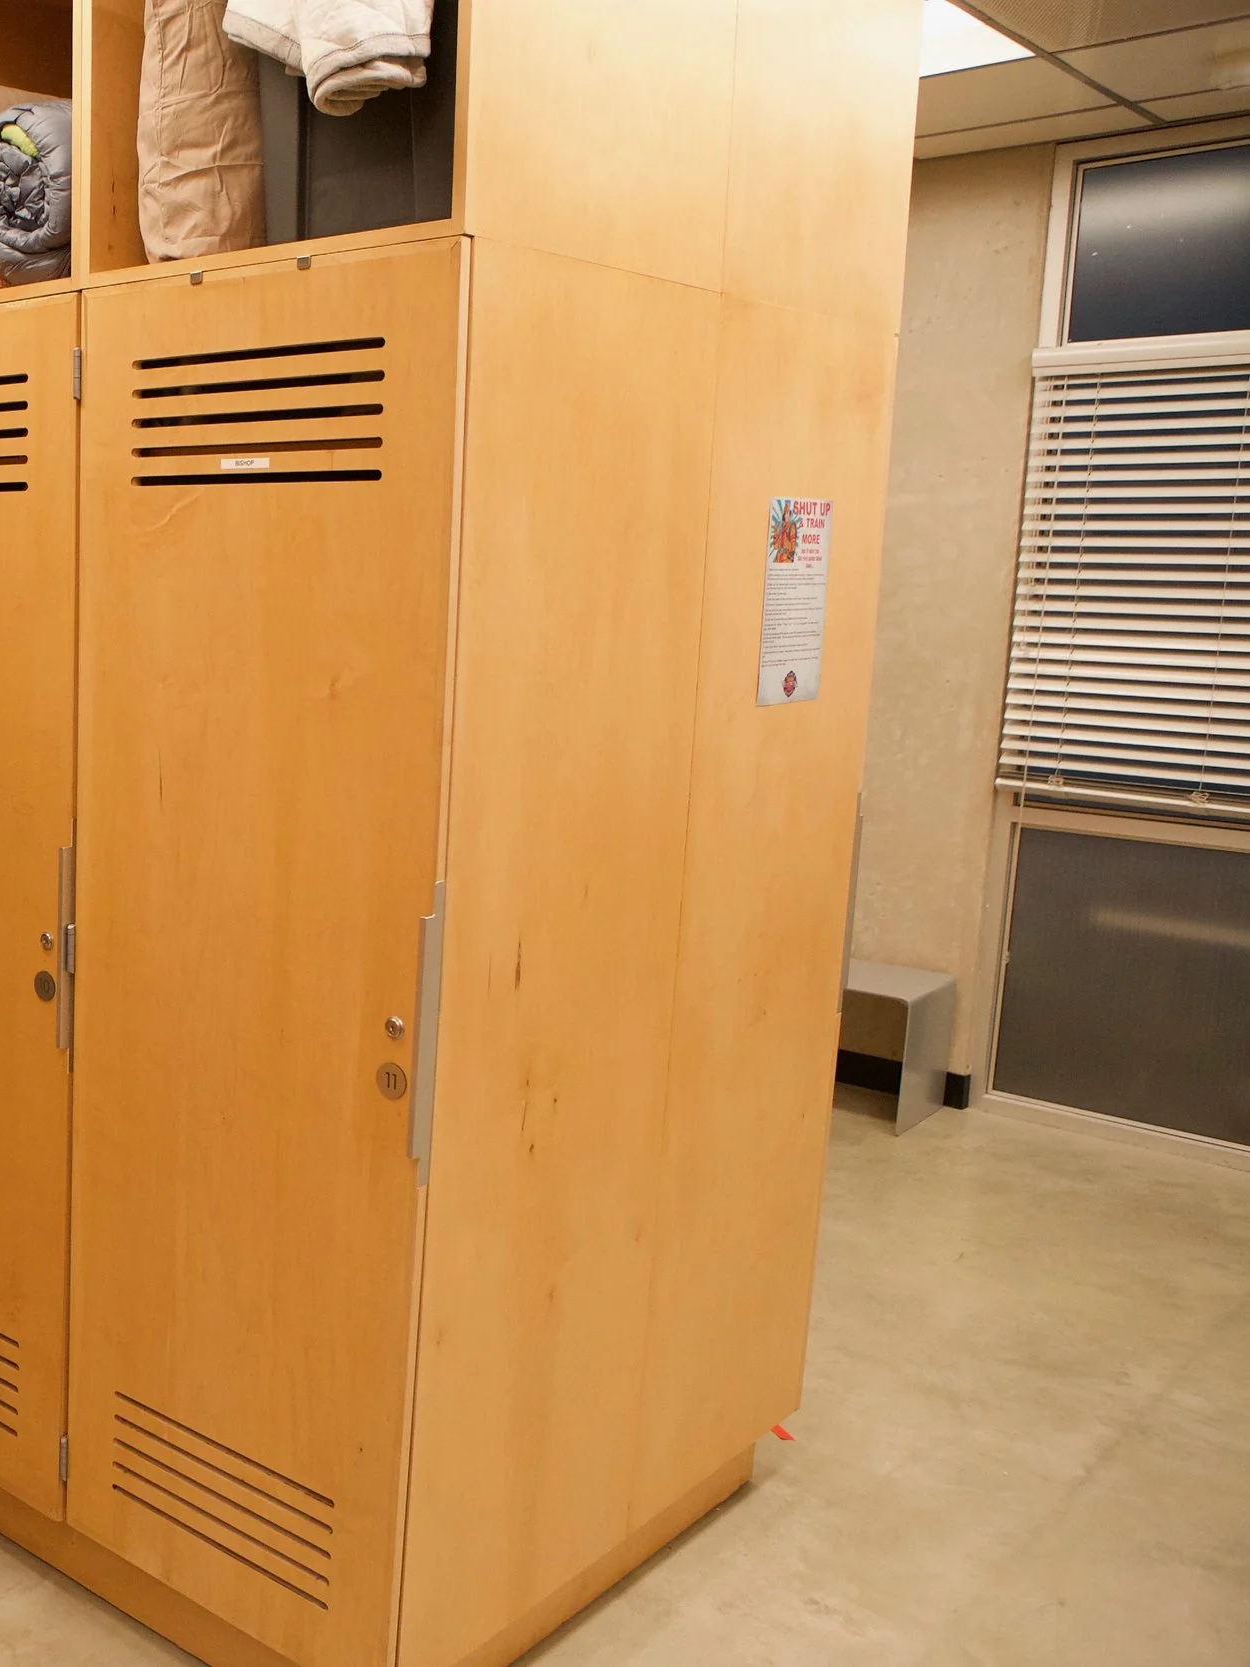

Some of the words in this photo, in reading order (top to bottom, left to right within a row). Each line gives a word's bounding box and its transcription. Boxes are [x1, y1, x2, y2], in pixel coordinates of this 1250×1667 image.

[235, 459, 255, 467] BISHOP
[793, 500, 818, 516] SHUT
[820, 501, 831, 516] UP
[806, 518, 825, 529] TRAIN
[801, 534, 821, 544] MORE
[39, 978, 51, 993] 10
[385, 1071, 397, 1090] 11
